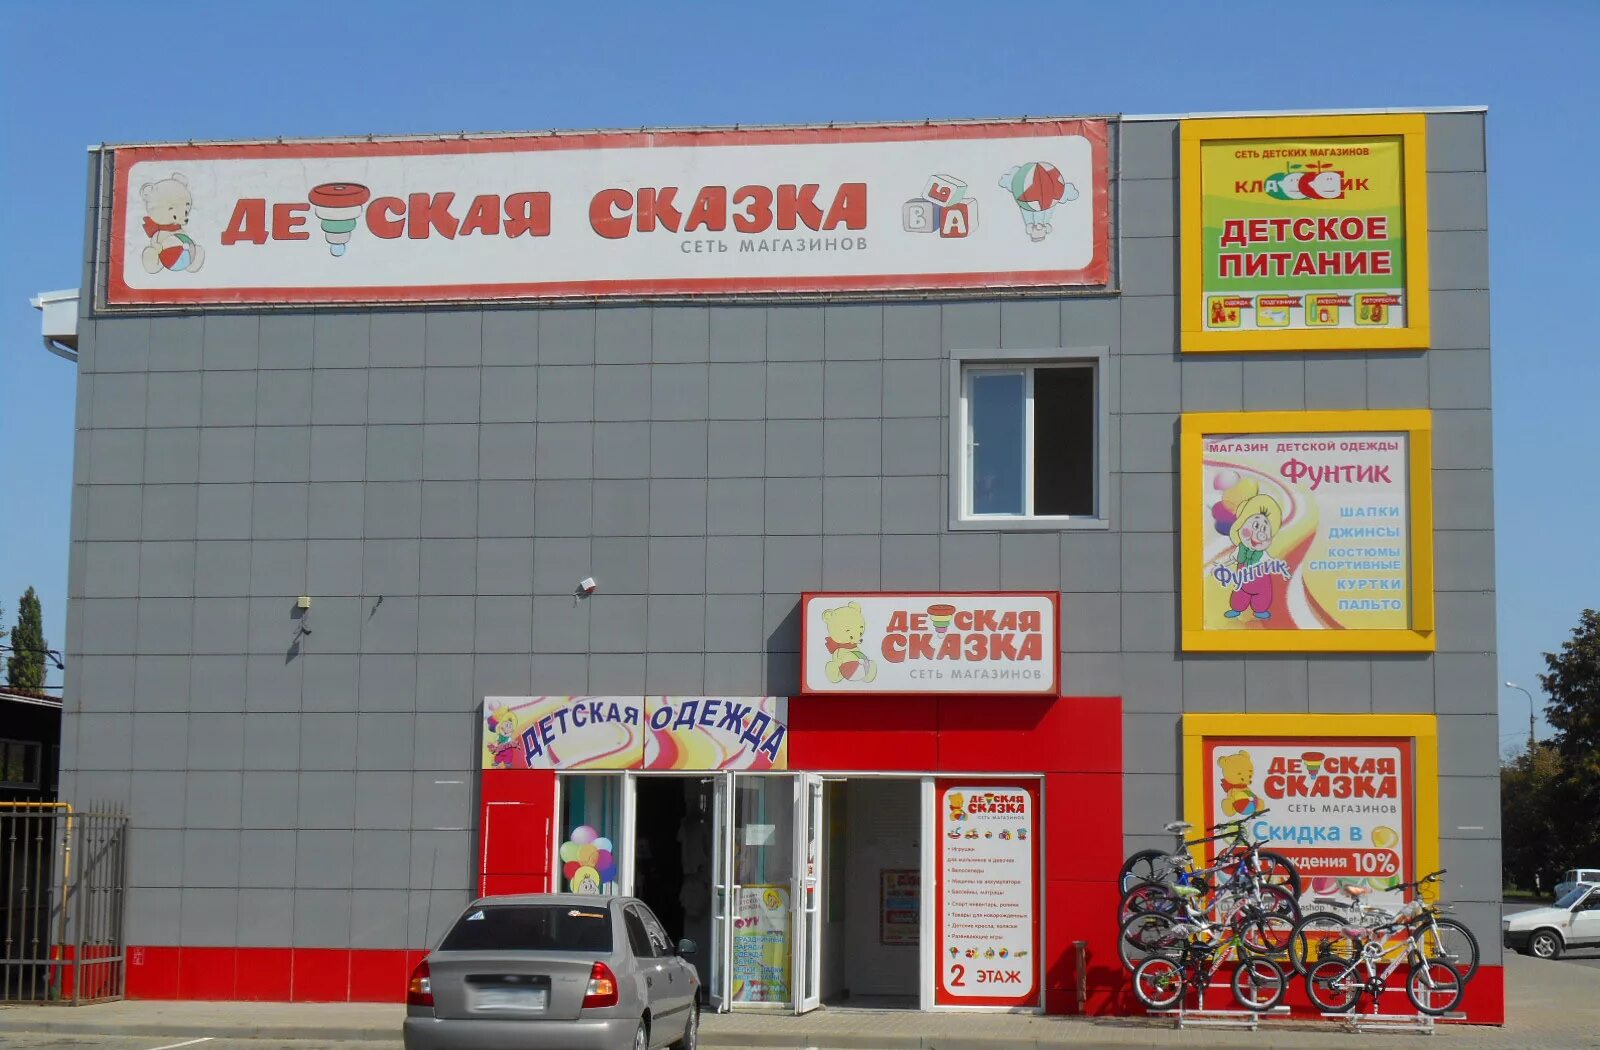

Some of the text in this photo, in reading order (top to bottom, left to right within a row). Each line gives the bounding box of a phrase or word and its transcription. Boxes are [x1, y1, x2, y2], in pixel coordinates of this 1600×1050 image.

[1235, 147, 1370, 159] СЕТЬ ДЕТСКИХ МАГАЗИНОВ
[588, 182, 868, 239] СКАЗКА
[1220, 216, 1388, 248] ДЕТСКОЕ
[680, 238, 868, 253] СЕТЬ МАГАЗИНОВ
[1219, 251, 1391, 278] ПИТАНИЕ
[1209, 442, 1399, 453] МАГАЗИН ДЕТСКОЙ ОДЕЖДЫ
[1340, 506, 1400, 518] ШАПКИ
[1328, 527, 1400, 539] ДЖИНСЫ
[1328, 548, 1400, 557] КОСТЮМЫ
[1309, 560, 1401, 570] СПОРТИВНЫЕ
[1337, 580, 1401, 590] КУРТКИ
[1338, 600, 1401, 610] ПАЛЬТО
[881, 633, 1043, 663] СКАЗКА
[909, 669, 1042, 679] СЕТЬ МАГАЗИНОВ
[520, 699, 786, 767] ДЕТСКАЯ ОДЕЖДА
[1264, 775, 1398, 799] СКАЗКА
[968, 803, 1025, 814] СКАЗКА
[1288, 804, 1397, 813] СЕТЬ МАГАЗИНОВ
[1253, 821, 1341, 844] Скидка
[1352, 852, 1396, 873] 10%
[951, 963, 1022, 988] 2 ЭТАЖ
